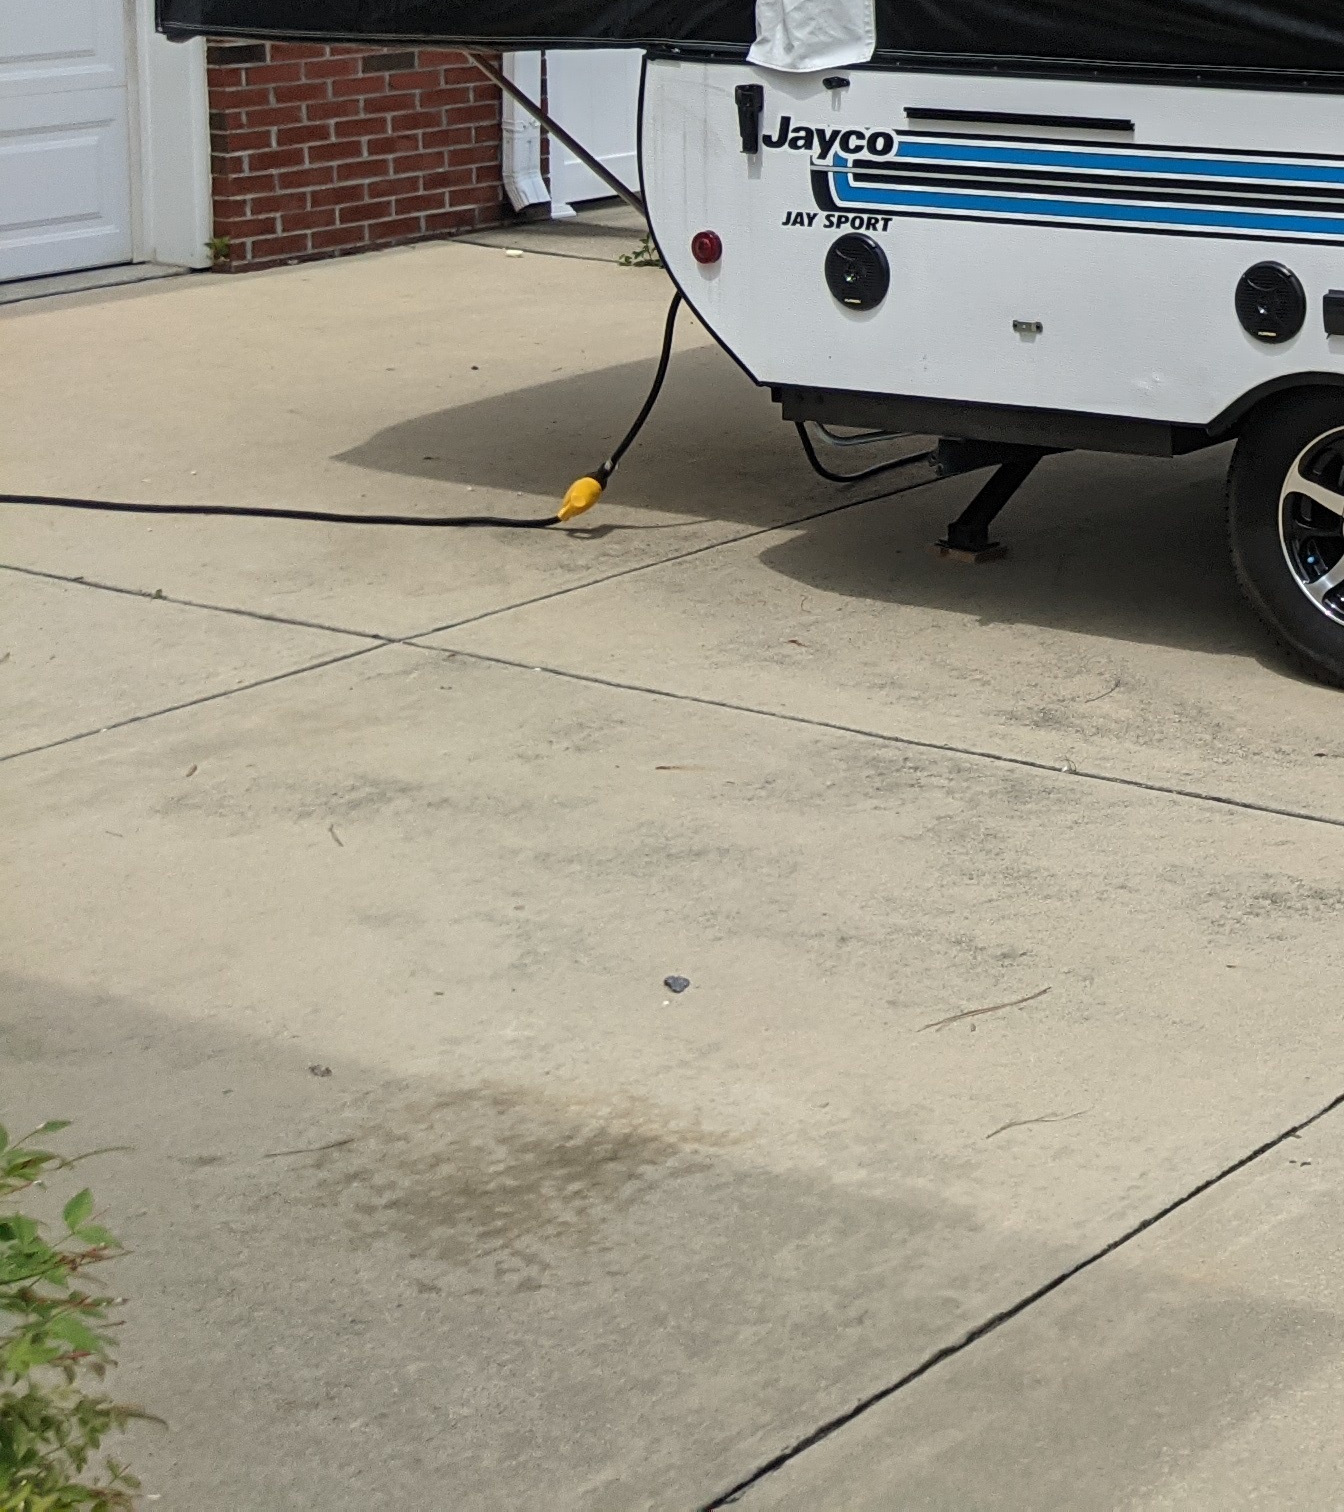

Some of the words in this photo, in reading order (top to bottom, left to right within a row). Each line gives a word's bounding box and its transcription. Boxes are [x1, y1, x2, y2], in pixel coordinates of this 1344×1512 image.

[762, 116, 894, 160] Jayco
[782, 211, 818, 227] JAY
[823, 214, 893, 232] SPORT
